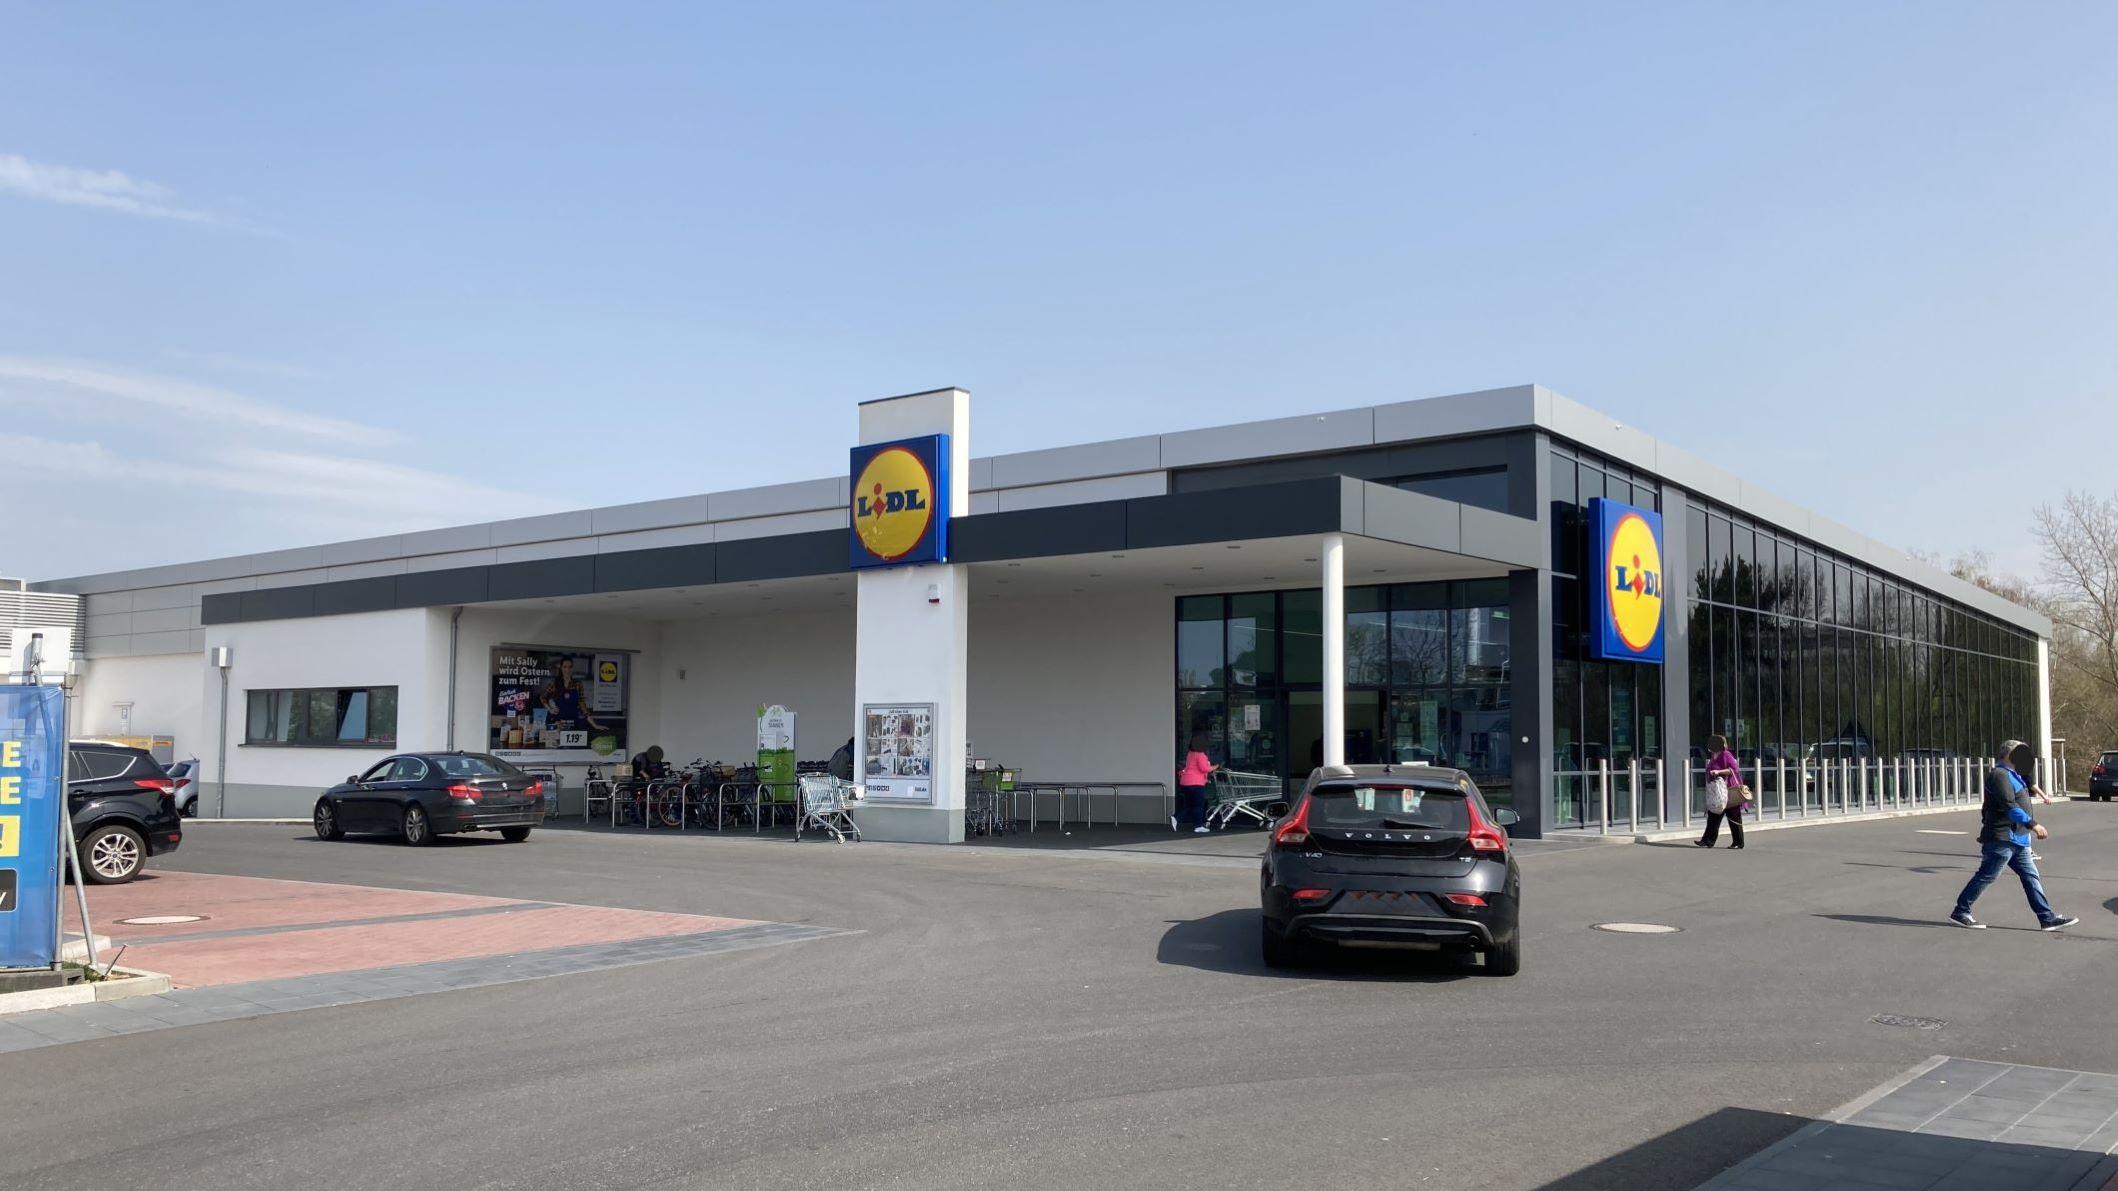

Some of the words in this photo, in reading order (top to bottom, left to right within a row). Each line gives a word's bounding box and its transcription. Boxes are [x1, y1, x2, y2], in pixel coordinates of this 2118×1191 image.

[499, 656, 515, 665] Mit
[516, 656, 538, 667] Sally
[499, 666, 519, 676] wird
[520, 666, 550, 676] Ostern
[520, 677, 540, 686] Fest!
[498, 691, 530, 705] BACKEN
[1344, 832, 1431, 841] VOLVO
